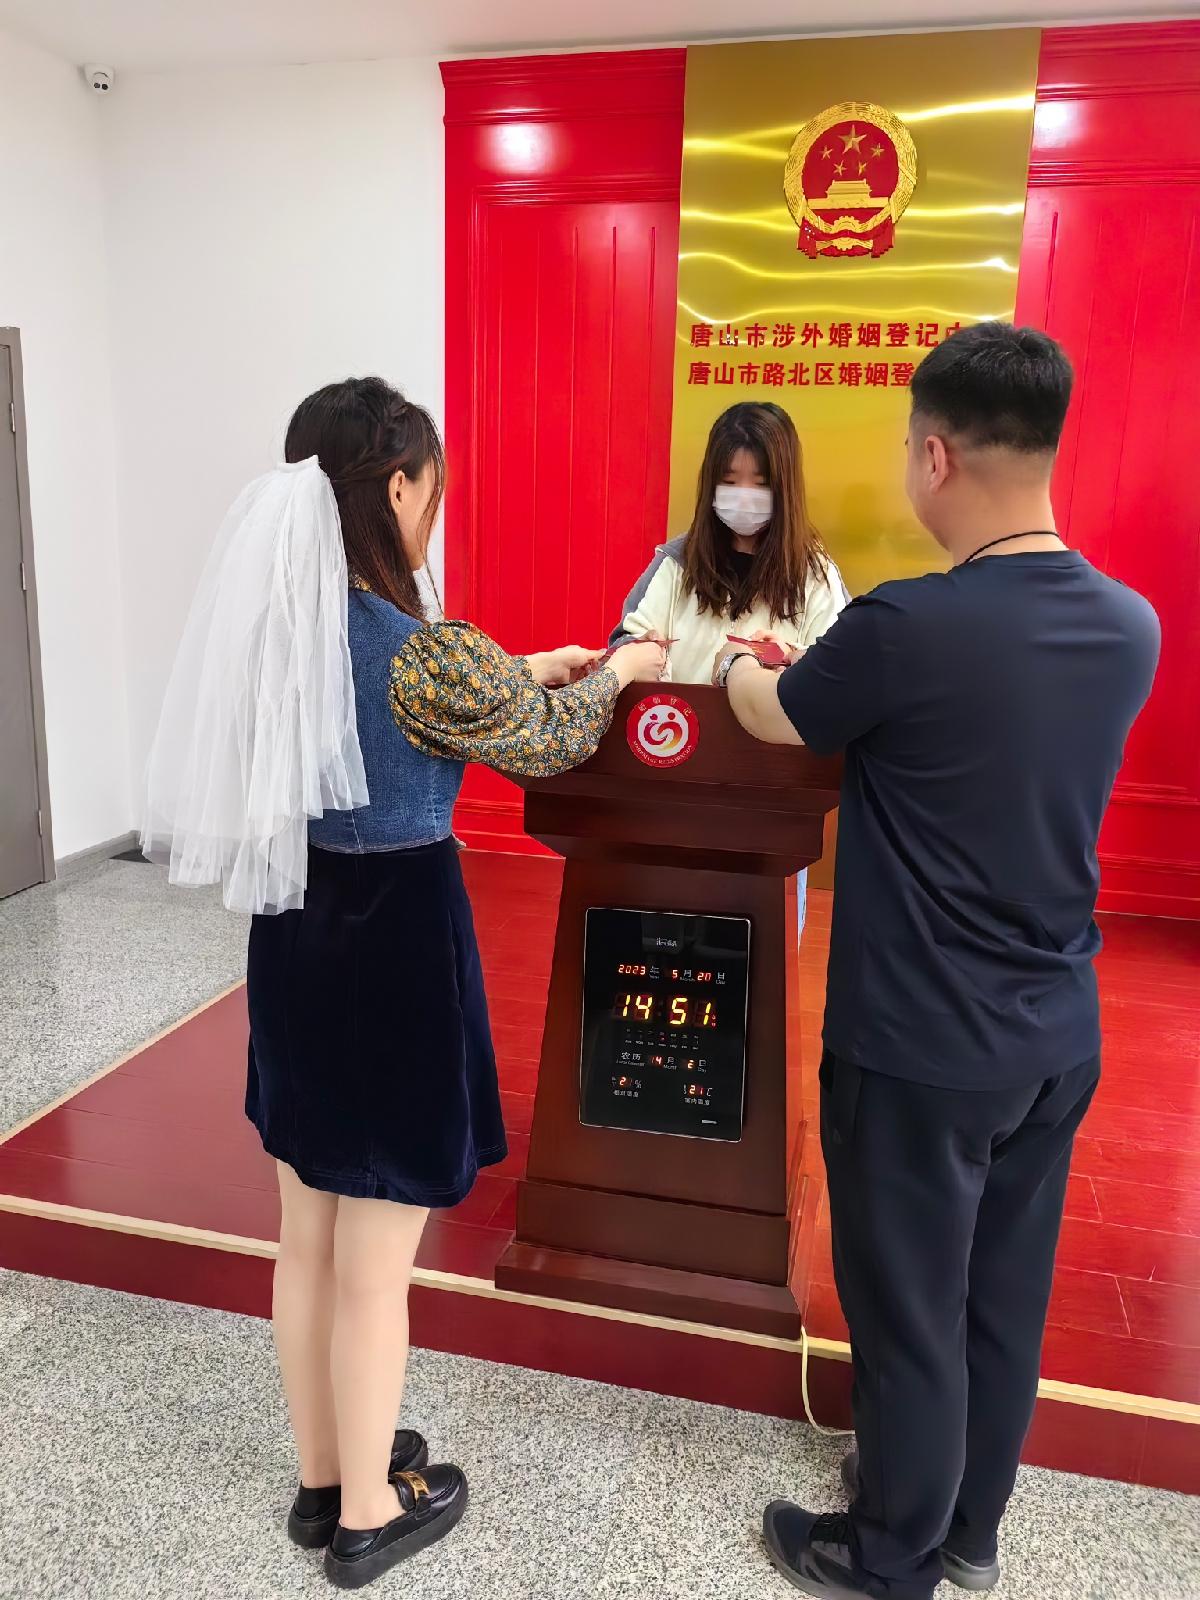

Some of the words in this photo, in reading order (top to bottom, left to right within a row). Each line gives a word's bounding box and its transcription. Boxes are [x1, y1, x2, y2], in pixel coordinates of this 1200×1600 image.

[618, 964, 646, 976] 2023
[672, 969, 678, 979] 5
[697, 971, 712, 981] 20
[622, 994, 653, 1020] 14
[670, 997, 712, 1025] 51
